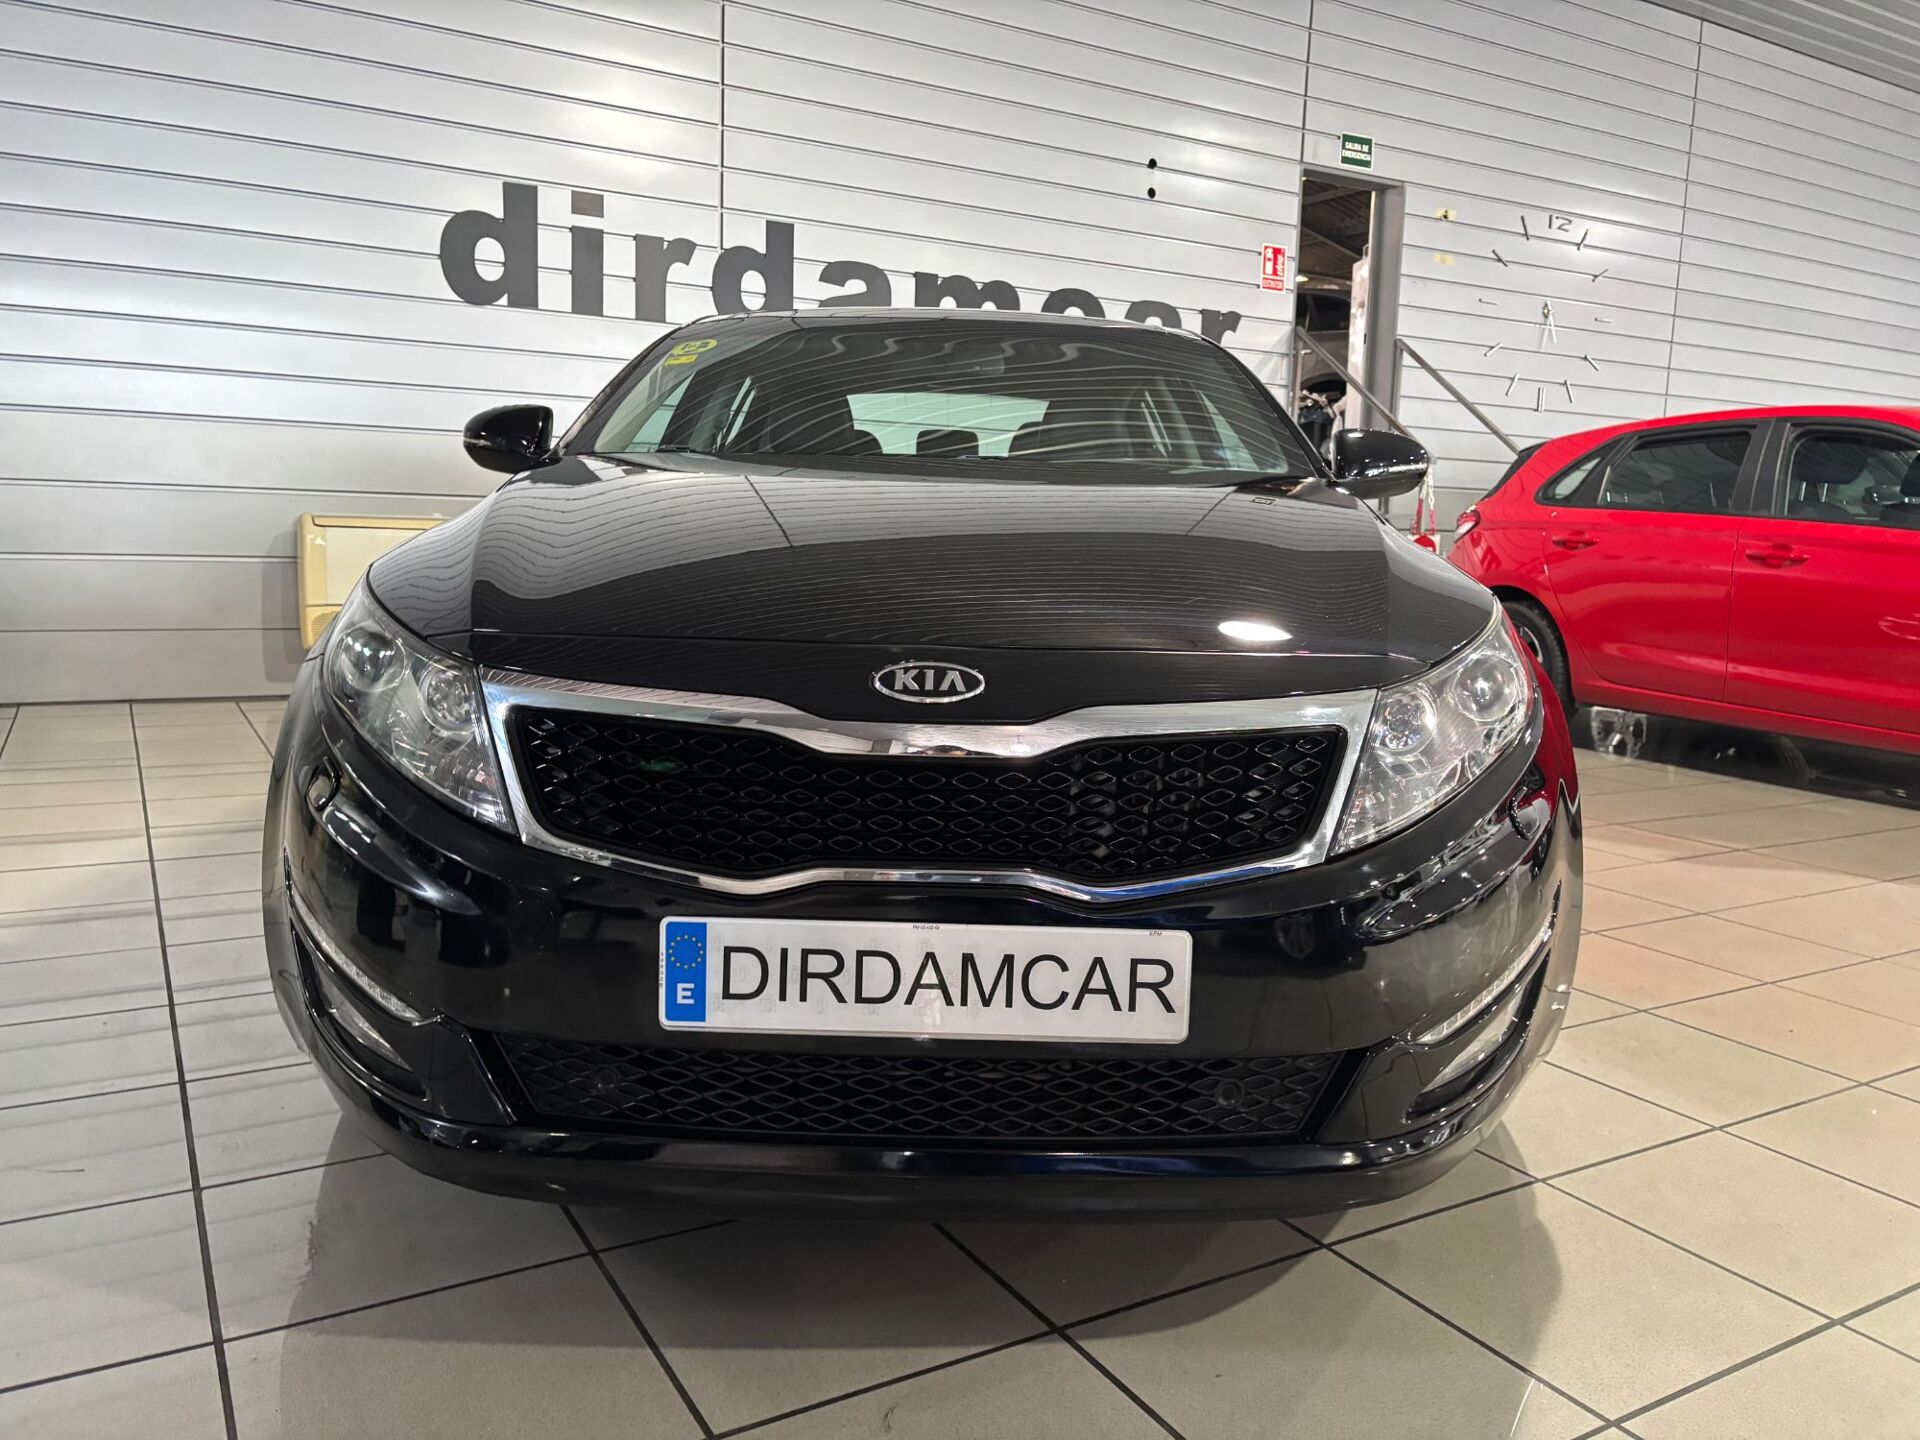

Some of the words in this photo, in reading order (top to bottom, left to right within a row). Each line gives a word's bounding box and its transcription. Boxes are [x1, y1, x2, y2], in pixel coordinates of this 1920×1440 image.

[1548, 214, 1573, 232] 12
[893, 669, 967, 692] KIA
[721, 945, 1176, 1014] DIRDAMCAR
[676, 982, 695, 1005] E
